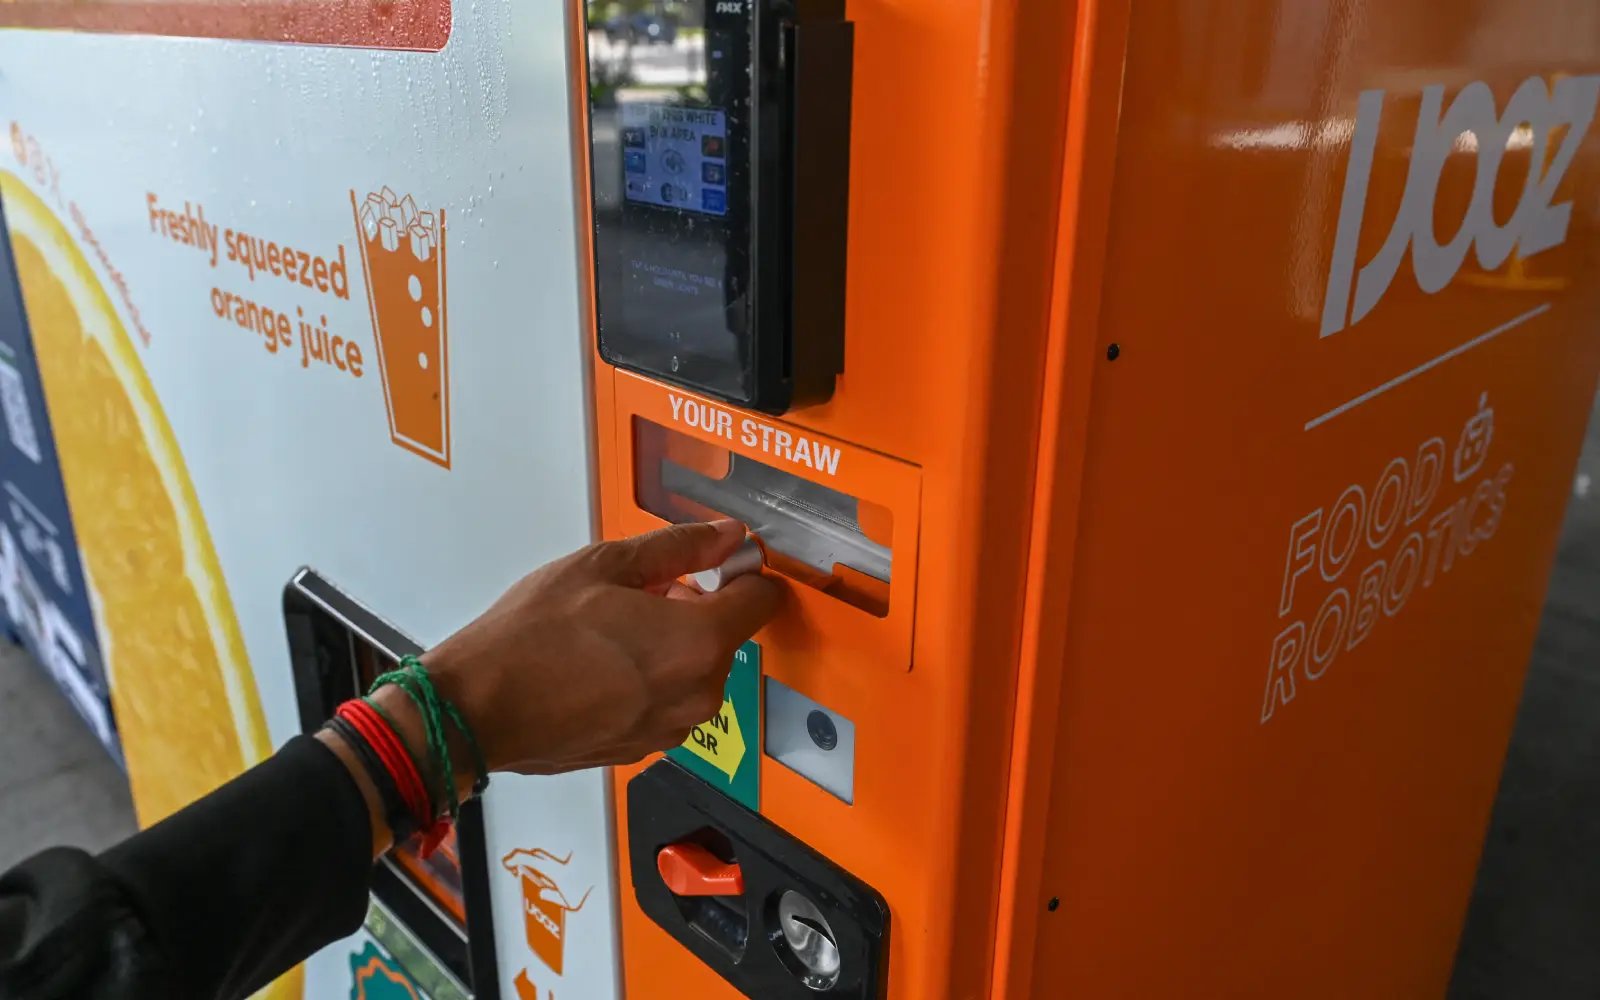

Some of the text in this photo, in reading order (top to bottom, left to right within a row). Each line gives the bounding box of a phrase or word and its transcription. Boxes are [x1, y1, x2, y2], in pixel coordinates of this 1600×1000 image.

[715, 1, 743, 14] PAX
[672, 128, 696, 142] AREA
[685, 111, 717, 125] WHITE
[146, 192, 218, 268] Freshly
[224, 228, 350, 301] squeezed
[211, 287, 363, 378] orange juice
[668, 394, 841, 476] YOUR STRAW
[1278, 435, 1446, 618] FOOD
[1260, 460, 1516, 725] ROBOTICS
[691, 725, 718, 756] QR
